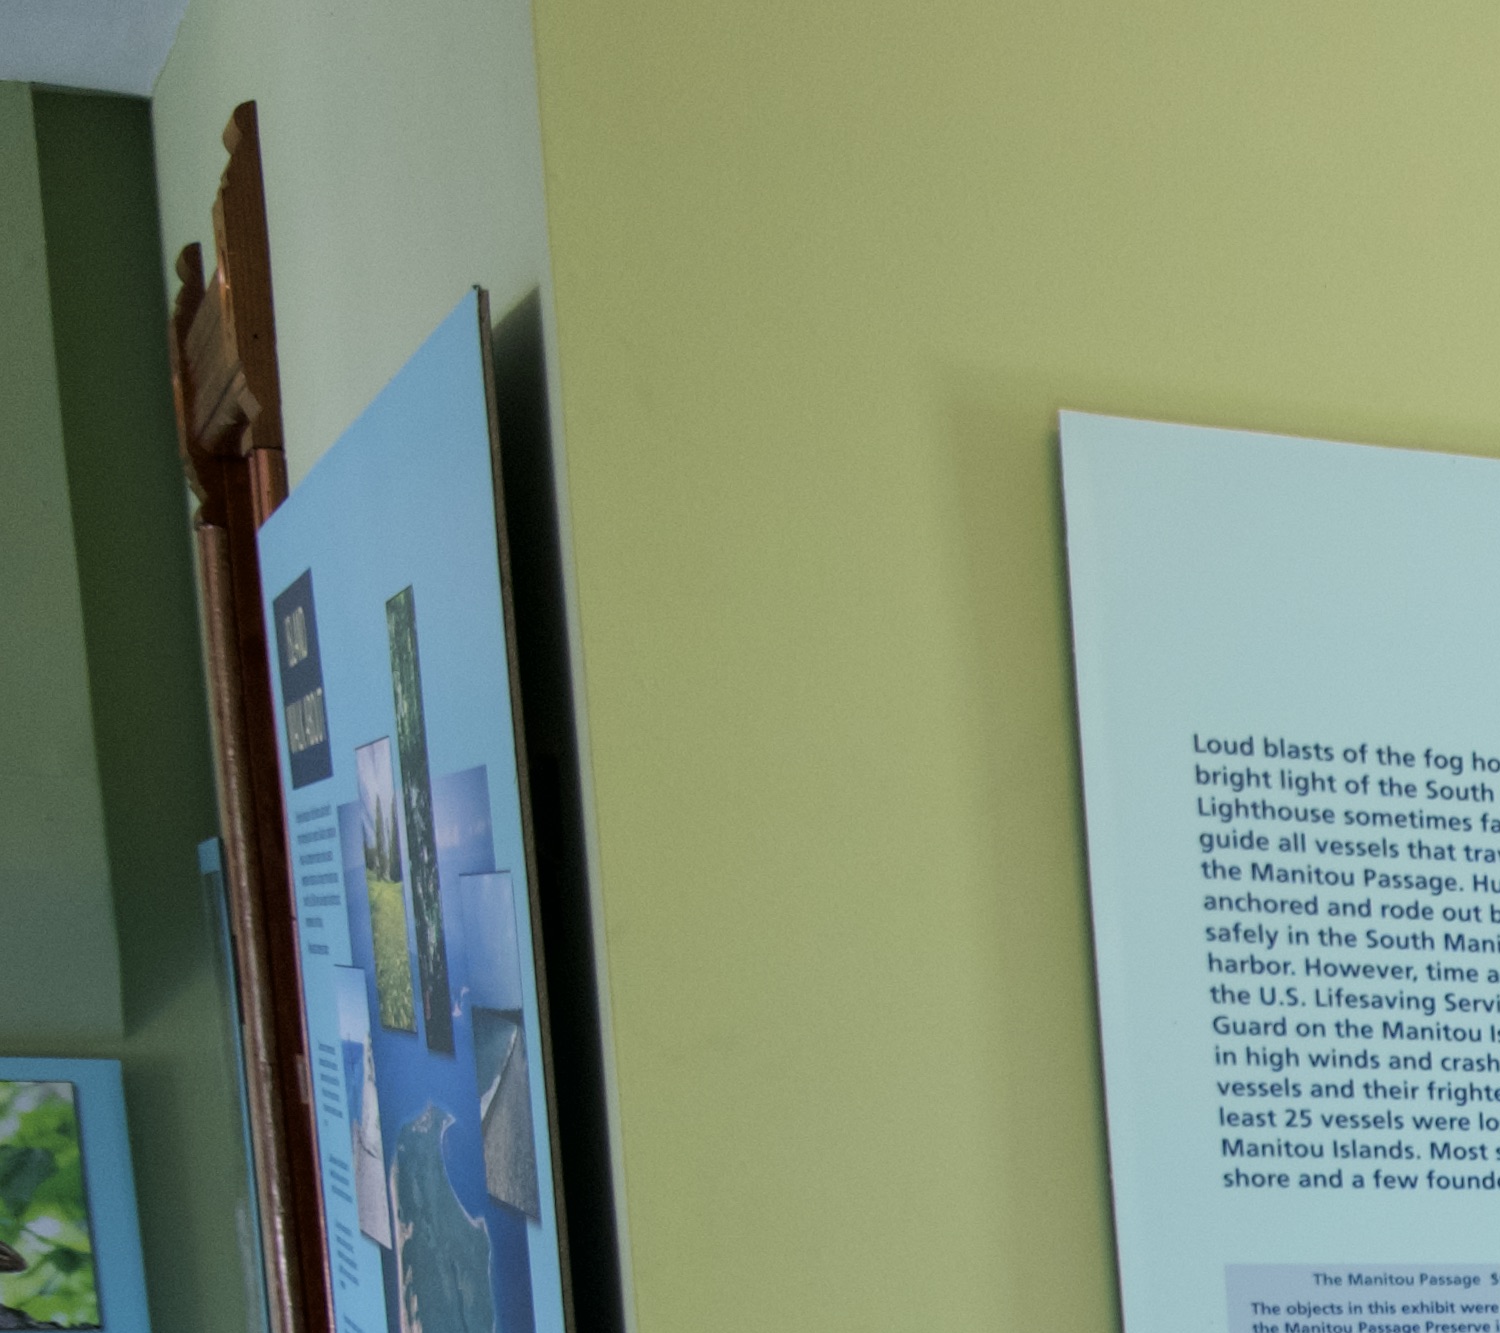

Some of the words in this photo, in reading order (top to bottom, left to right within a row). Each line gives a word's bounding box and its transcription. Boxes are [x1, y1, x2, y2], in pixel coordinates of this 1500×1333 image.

[1193, 733, 1255, 757] Loud
[1263, 736, 1335, 762] blasts
[1342, 743, 1368, 764] of
[1375, 745, 1416, 768] the
[1423, 748, 1464, 776] fog
[1195, 763, 1272, 793] bright
[1279, 769, 1337, 797] light
[1344, 774, 1370, 795] of
[1377, 776, 1418, 799] the
[1425, 779, 1495, 803] South
[1312, 1272, 1343, 1287] The
[1347, 1272, 1415, 1287] Manitou
[1419, 1272, 1481, 1290] Passage
